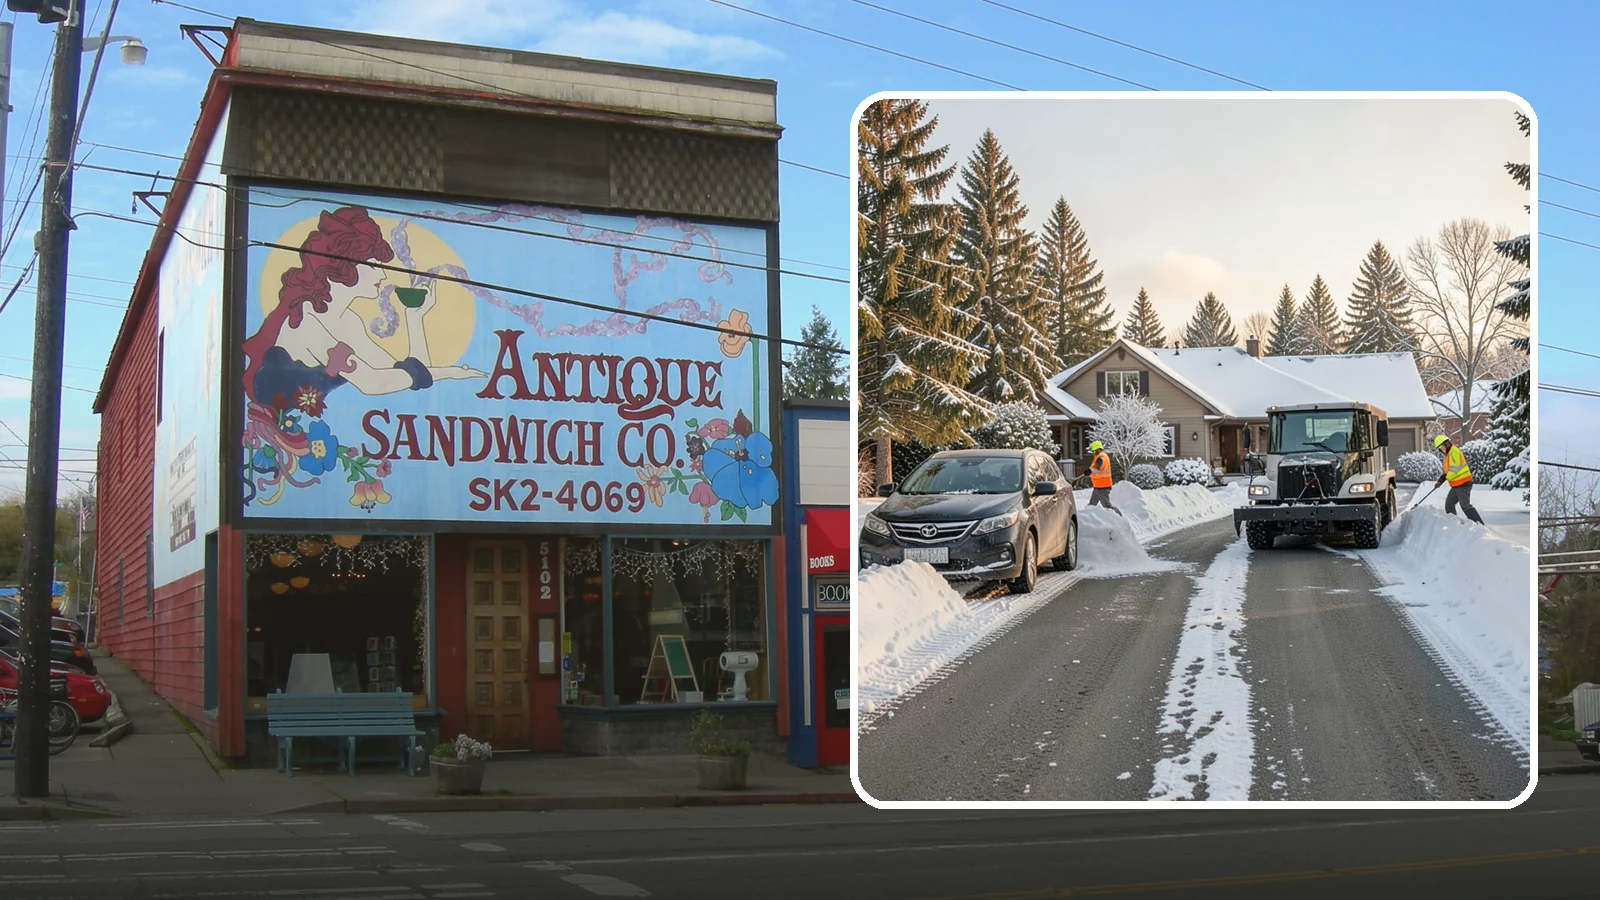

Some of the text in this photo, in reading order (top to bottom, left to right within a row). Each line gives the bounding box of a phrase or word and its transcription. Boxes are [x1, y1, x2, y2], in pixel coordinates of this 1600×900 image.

[475, 329, 723, 421] ANTIQUE
[361, 408, 684, 468] SANDWICH CO.
[468, 477, 645, 513] SK2-4069
[540, 541, 551, 600] 5102
[809, 555, 835, 569] BOOKS
